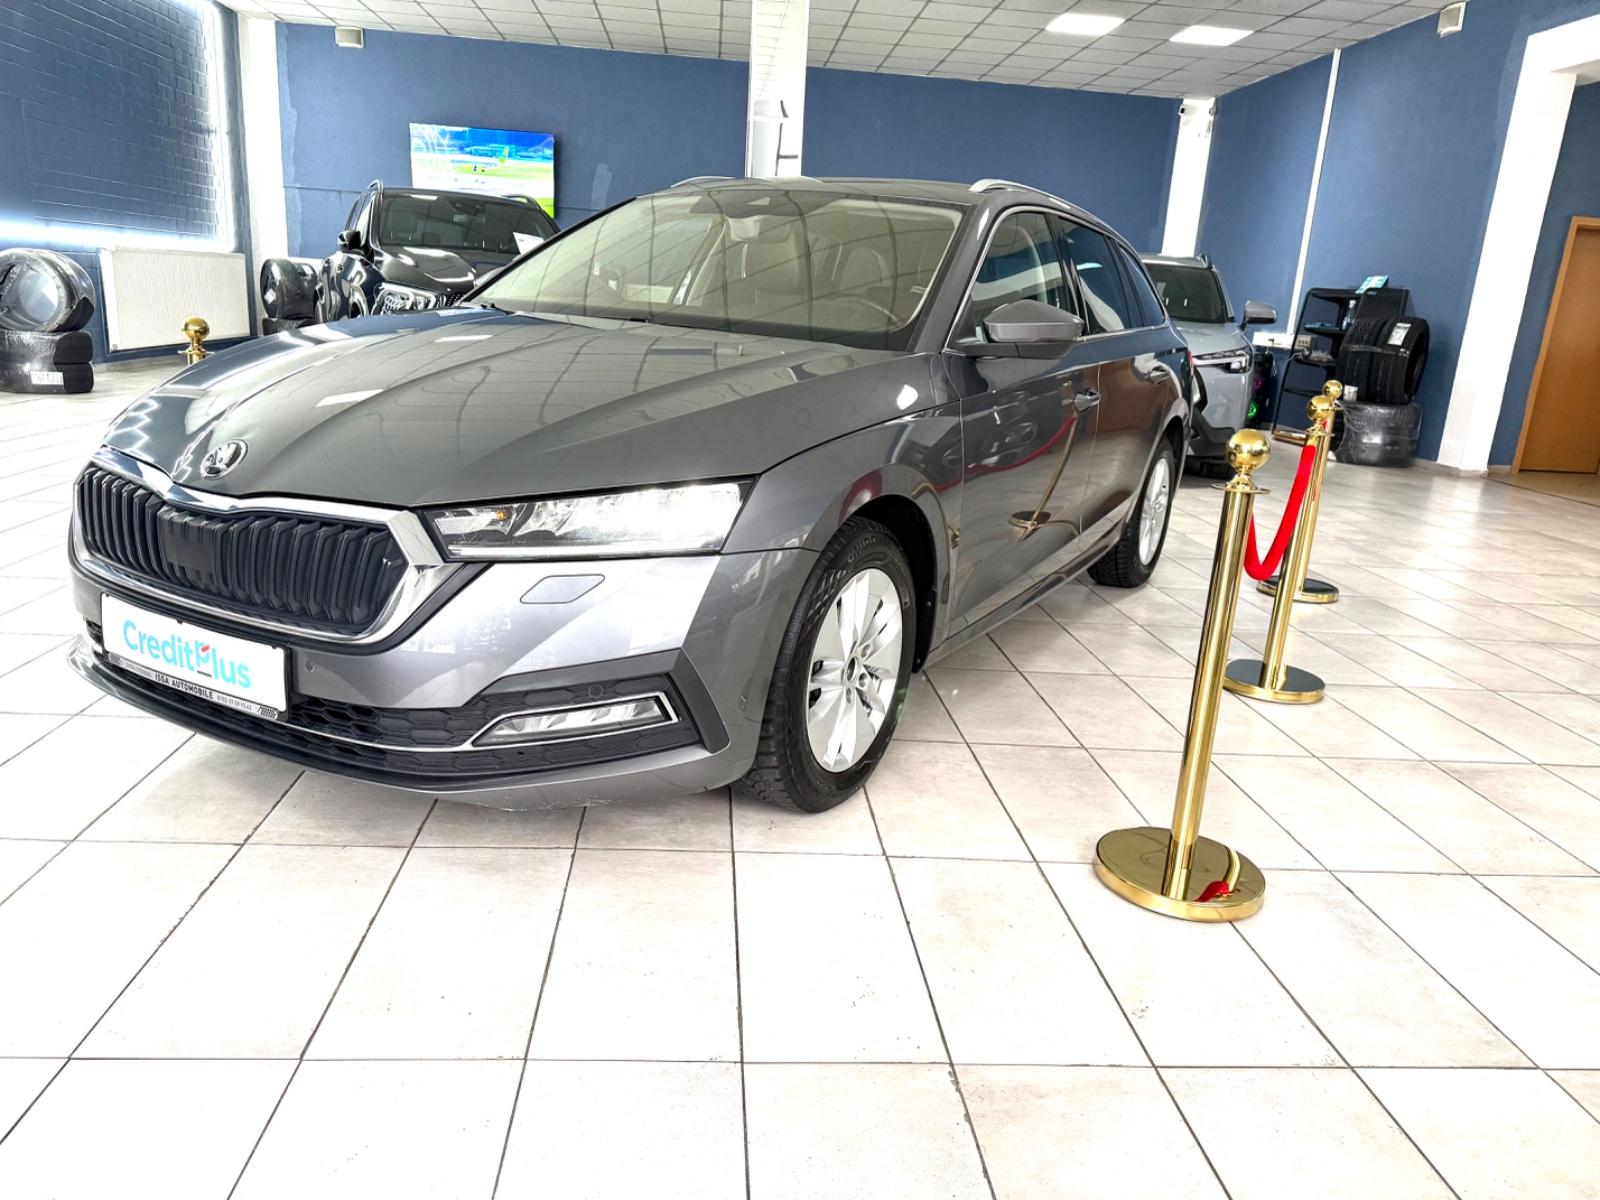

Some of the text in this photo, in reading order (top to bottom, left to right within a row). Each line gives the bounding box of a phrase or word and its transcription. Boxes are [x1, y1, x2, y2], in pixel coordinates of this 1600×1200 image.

[123, 619, 252, 689] CreditPlus
[154, 673, 214, 700] ISSA AUTOMOBILE
